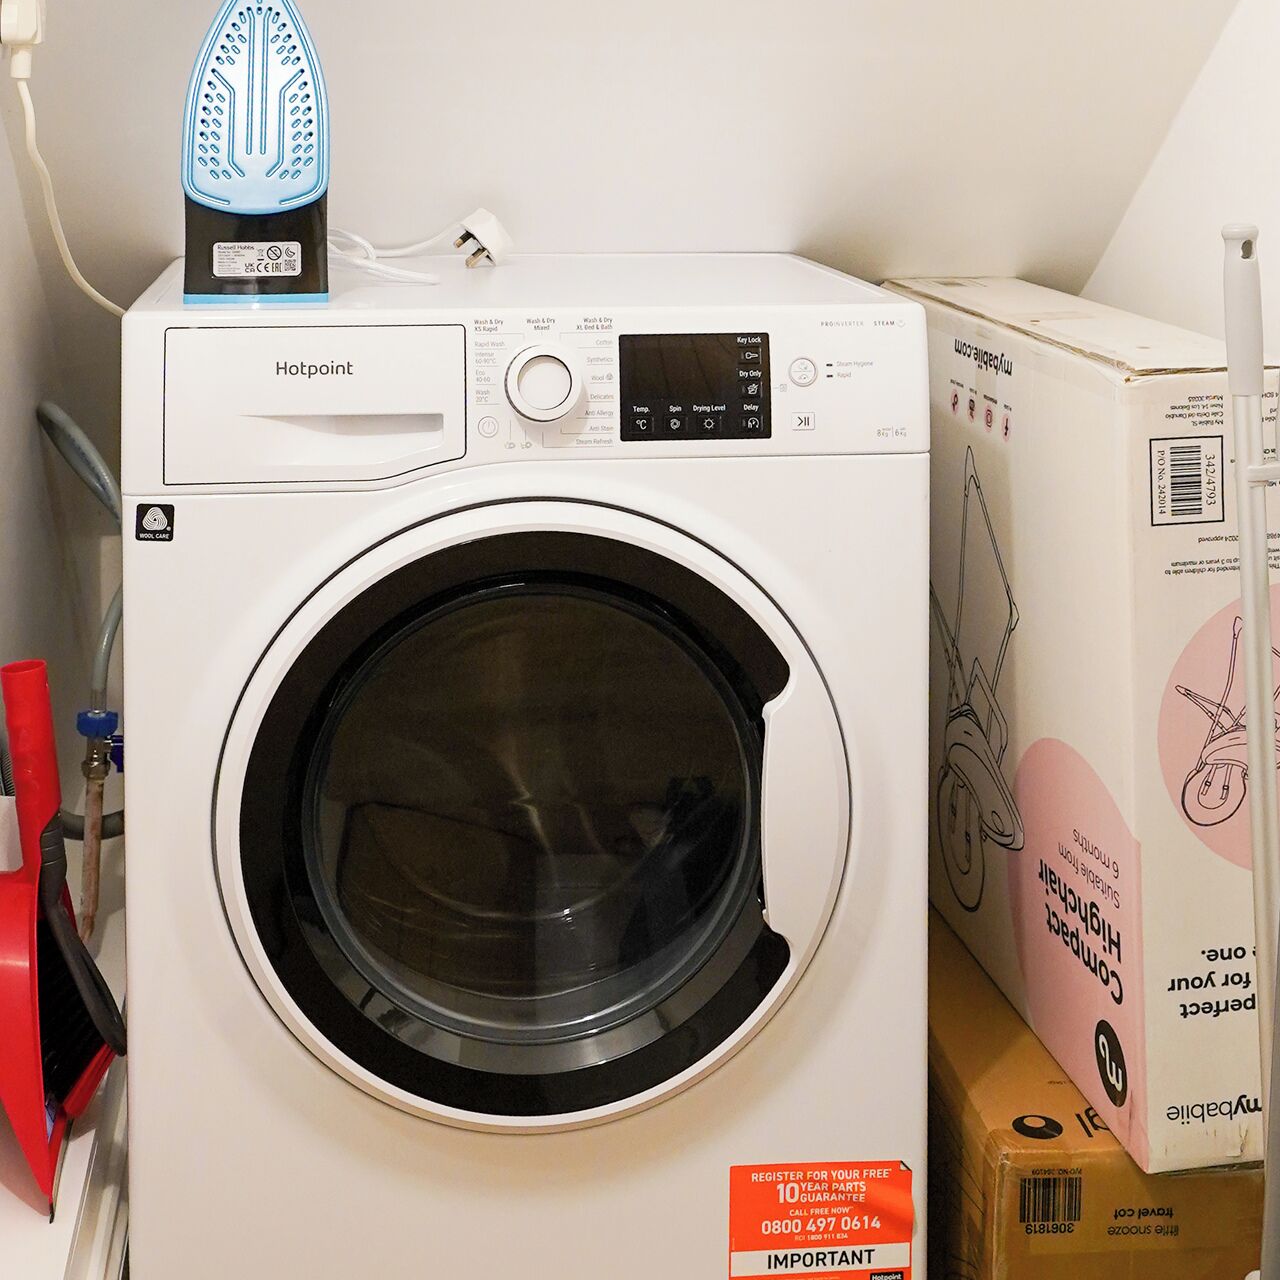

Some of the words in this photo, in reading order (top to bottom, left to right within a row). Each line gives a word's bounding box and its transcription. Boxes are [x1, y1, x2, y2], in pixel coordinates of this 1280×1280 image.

[737, 336, 747, 344] Key
[954, 338, 1013, 376] mybabiie.com
[275, 360, 354, 379] Hotpoint
[739, 370, 749, 378] Dry
[750, 370, 762, 378] Only
[693, 405, 710, 413] Drying
[743, 404, 759, 412] Delay
[1157, 450, 1165, 467] P/O
[1157, 468, 1166, 481] No.
[1205, 454, 1217, 506] 342/4793
[1158, 484, 1166, 515] 242014
[139, 532, 154, 540] WOOL
[155, 532, 170, 540] CARE
[1072, 828, 1110, 868] months
[1058, 842, 1080, 875] from
[1112, 860, 1120, 878] 6
[1081, 860, 1120, 909] Suitable
[1038, 858, 1122, 964] Highchair
[1045, 902, 1123, 1005] Compact
[1201, 945, 1246, 962] one.
[1167, 971, 1216, 992] your
[1221, 971, 1251, 989] for
[1179, 993, 1256, 1019] perfect
[751, 1171, 803, 1182] REGISTER
[806, 1170, 828, 1181] FOR
[831, 1169, 860, 1180] YOUR
[776, 1182, 799, 1204] 10
[800, 1182, 829, 1192] YEAR
[832, 1181, 866, 1192] PARTS
[800, 1193, 865, 1203] GUARANTEE
[789, 1209, 808, 1217] CALL
[810, 1208, 830, 1216] FREE
[1113, 1208, 1136, 1220] cot
[1138, 1207, 1175, 1220] travel
[761, 1220, 802, 1235] 0800
[806, 1218, 836, 1232] 497
[841, 1216, 881, 1231] 0614
[1107, 1225, 1151, 1236] snooze
[1155, 1224, 1179, 1237] little
[767, 1249, 876, 1269] IMPORTANT
